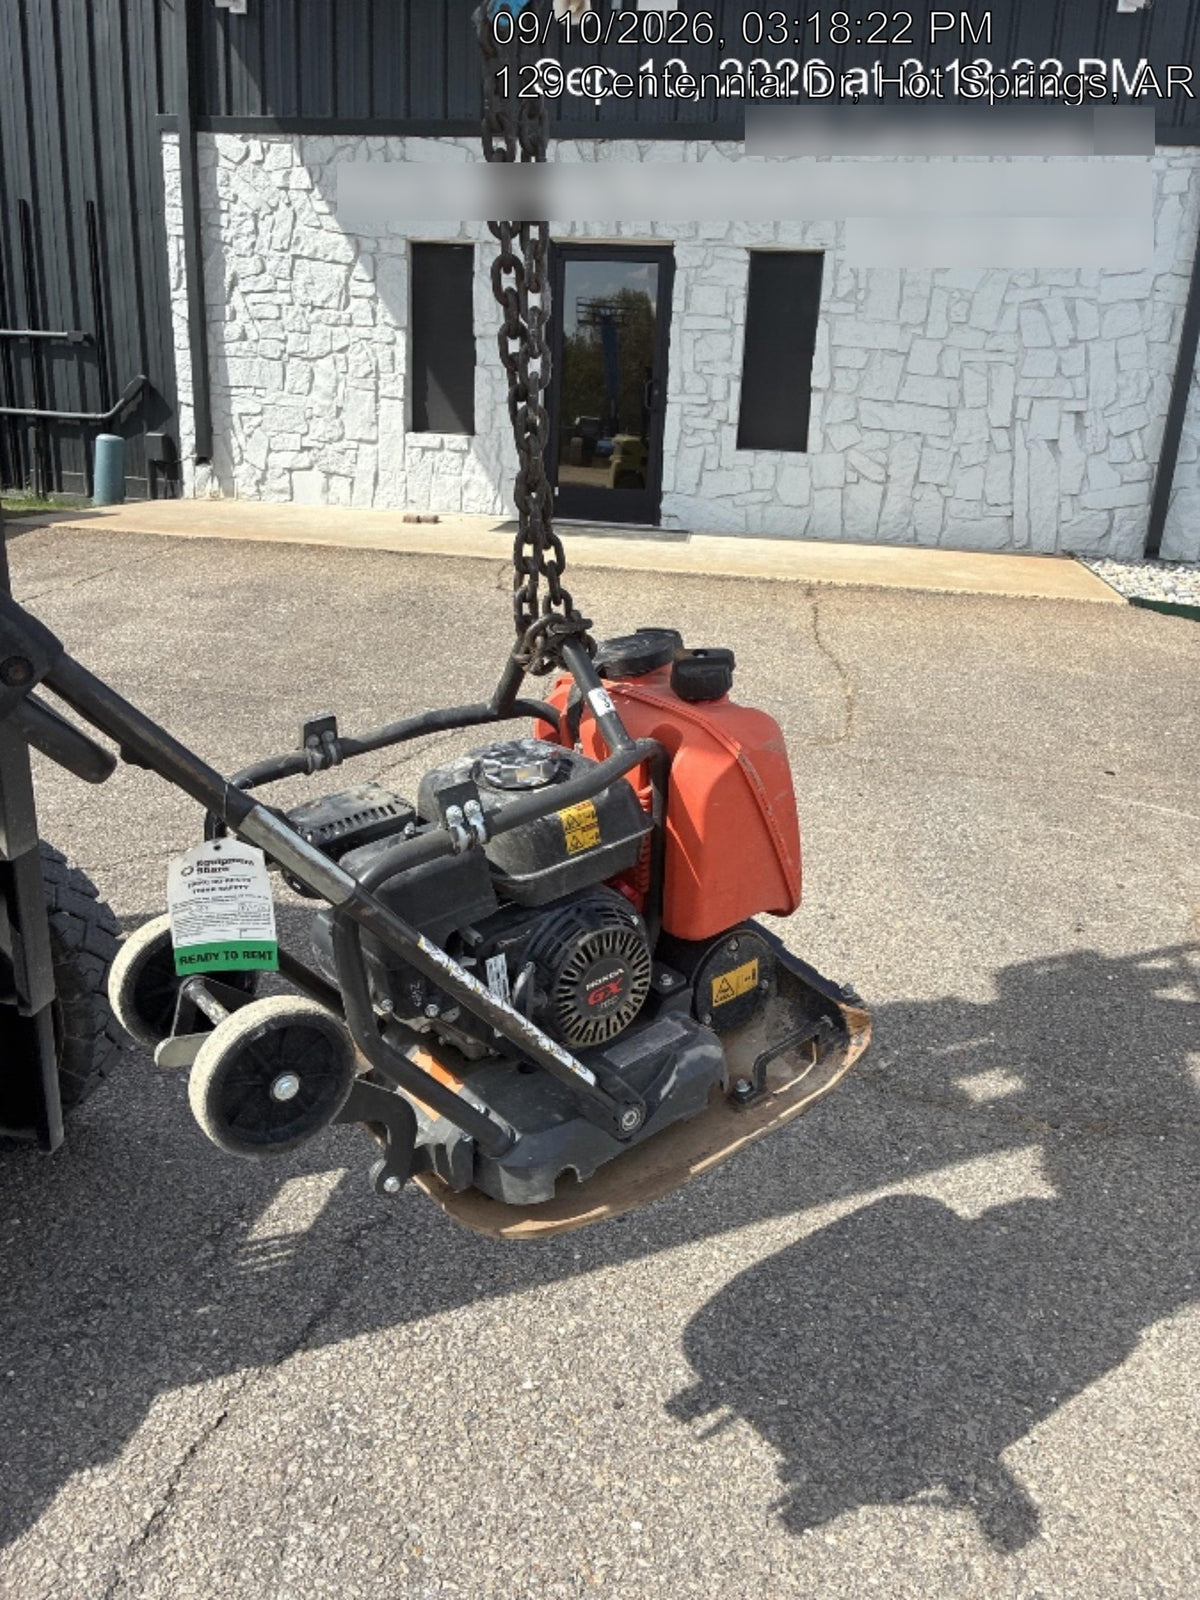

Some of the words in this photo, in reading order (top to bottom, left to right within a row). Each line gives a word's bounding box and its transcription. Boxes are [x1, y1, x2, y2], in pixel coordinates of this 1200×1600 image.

[179, 953, 219, 965] READY
[223, 951, 239, 960] TO
[242, 950, 274, 960] RENT
[585, 968, 625, 991] HONDA
[587, 977, 623, 1006] GX
